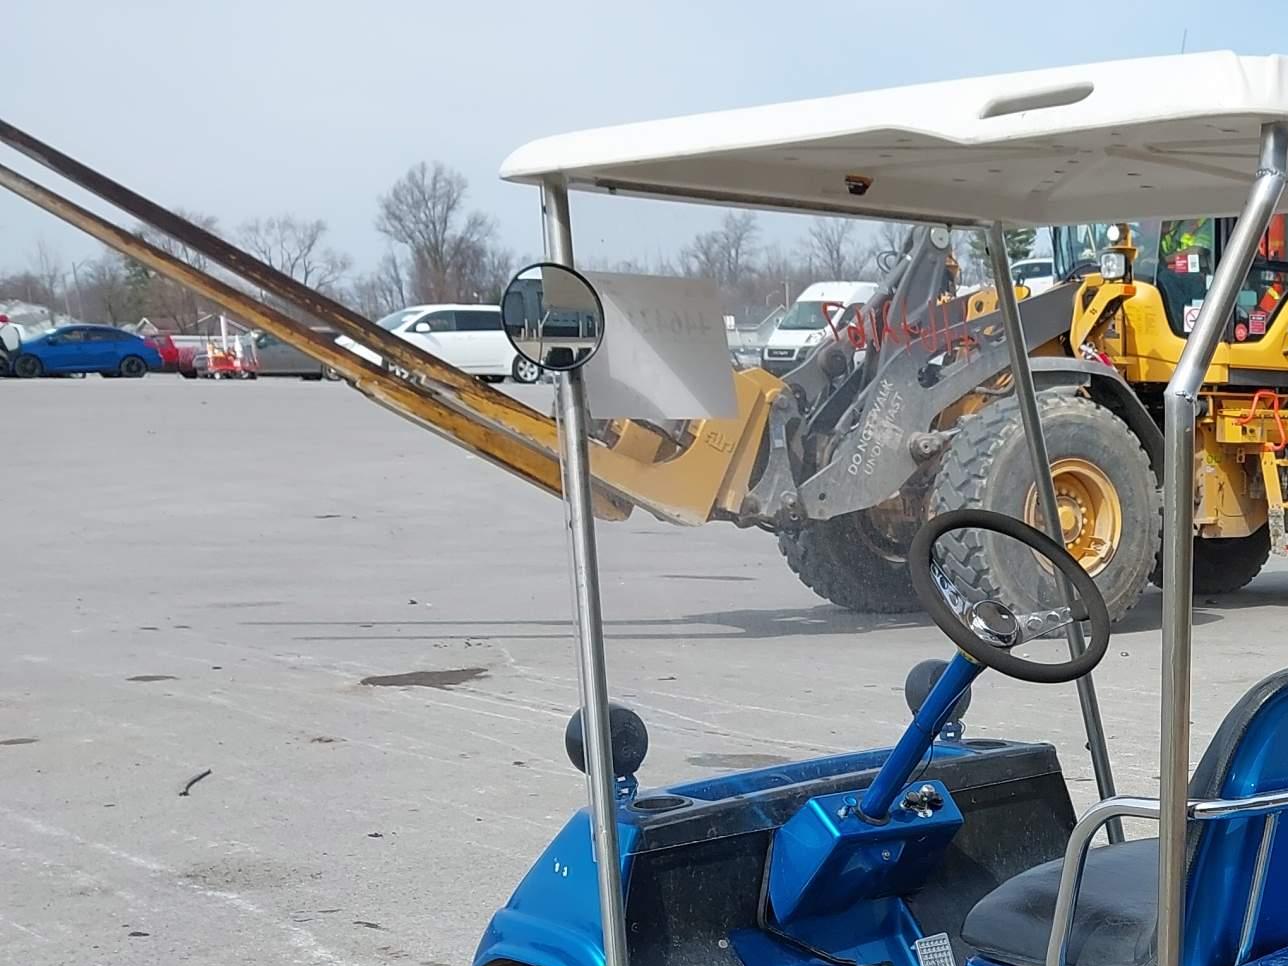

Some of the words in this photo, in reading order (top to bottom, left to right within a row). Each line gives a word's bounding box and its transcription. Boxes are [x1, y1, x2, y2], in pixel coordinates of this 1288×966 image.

[847, 453, 862, 475] DO
[857, 420, 873, 452] NOT
[867, 379, 894, 418] WALK
